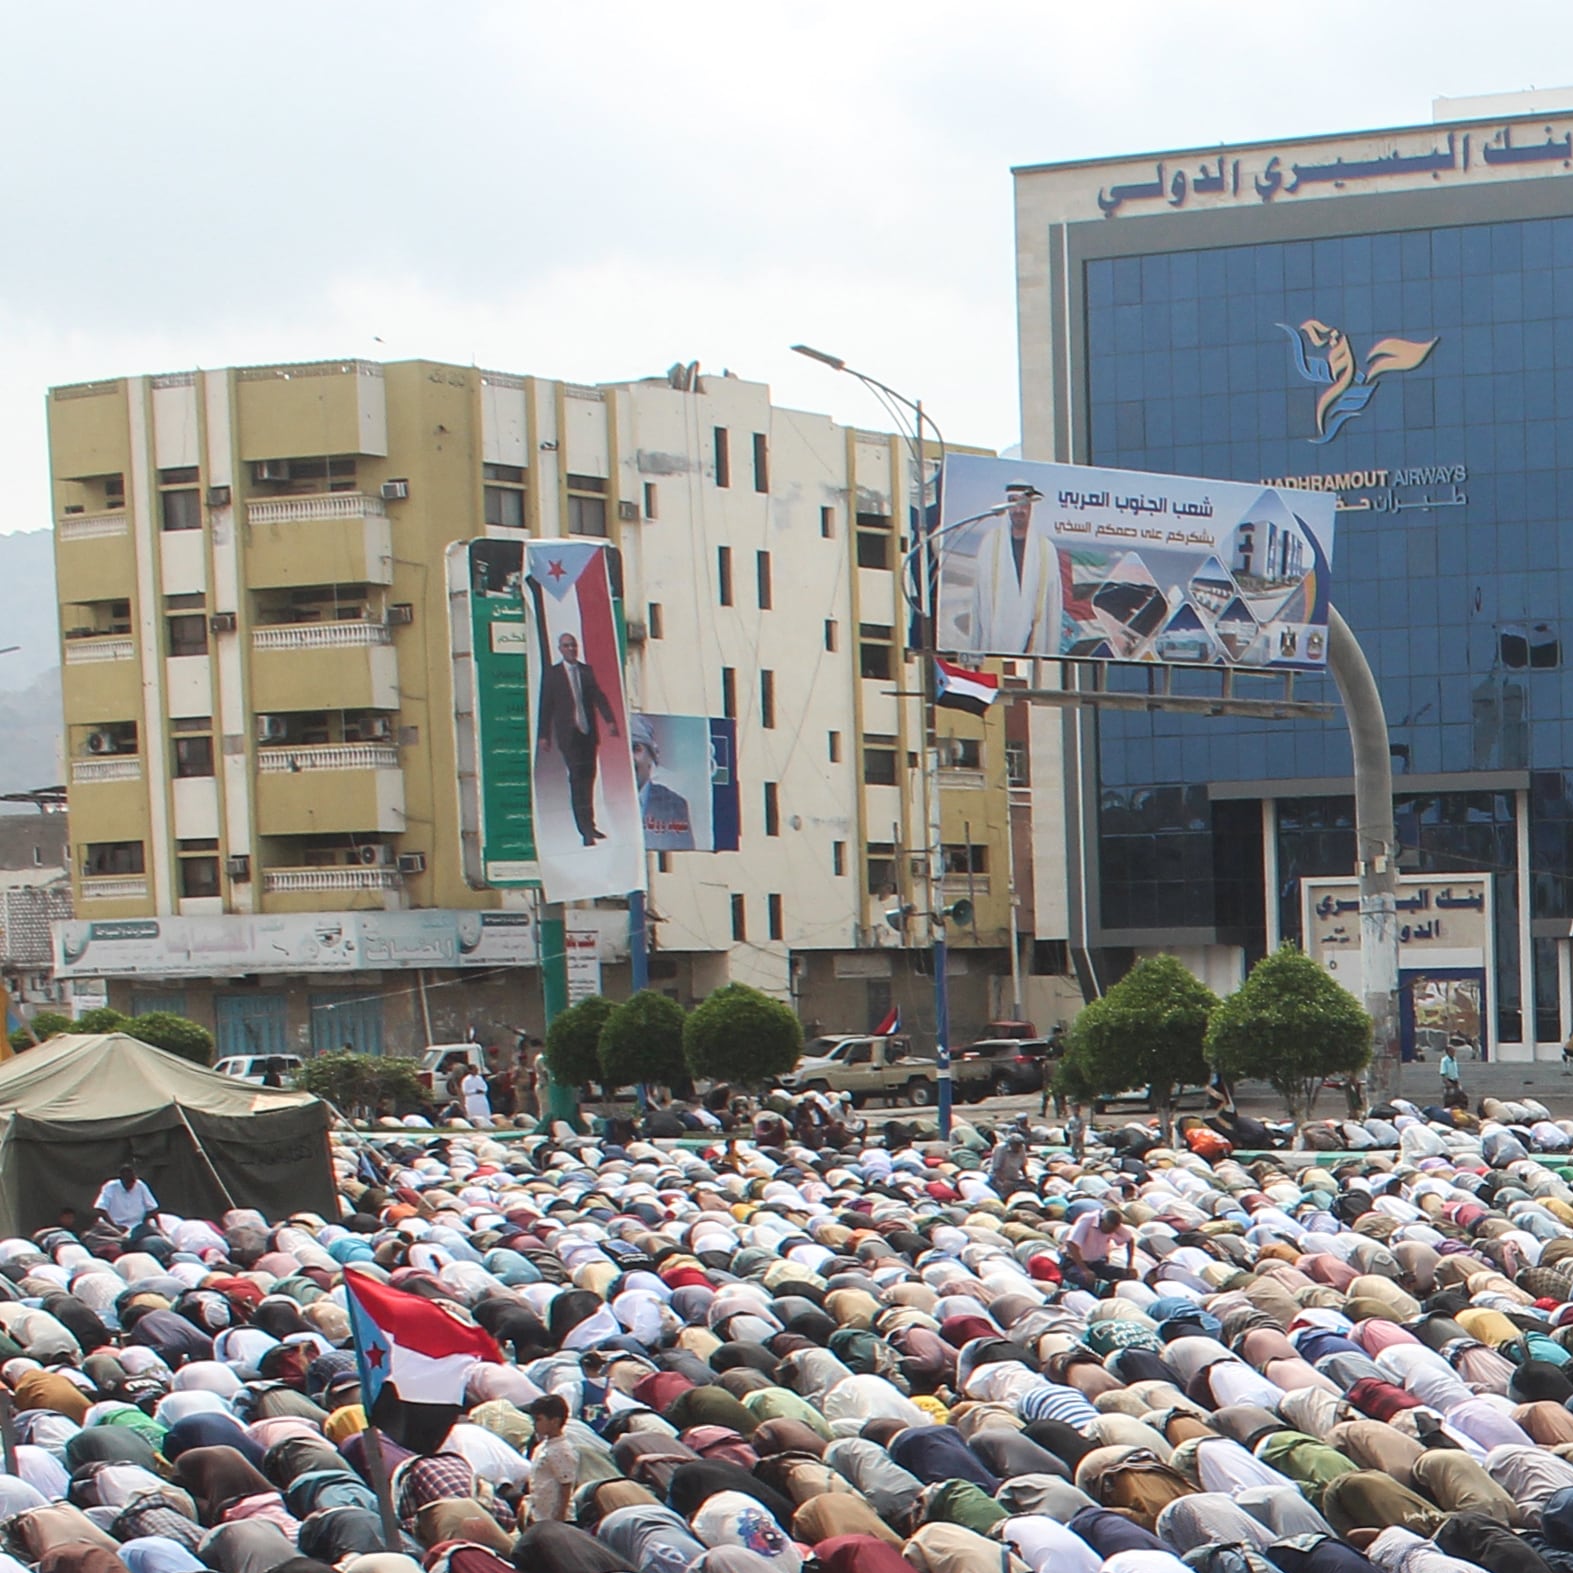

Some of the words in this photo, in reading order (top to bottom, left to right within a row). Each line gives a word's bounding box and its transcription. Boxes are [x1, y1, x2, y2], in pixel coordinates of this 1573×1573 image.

[1482, 125, 1573, 167] بنك
[1254, 131, 1471, 202] البسيري
[1098, 155, 1240, 217] الدولي
[1393, 465, 1467, 487] AIRWAYS
[1058, 489, 1110, 510] العربي
[1115, 494, 1168, 516] الجنوب
[1172, 496, 1214, 519] شعب
[1316, 888, 1430, 919] البري
[1435, 887, 1484, 914] بنك
